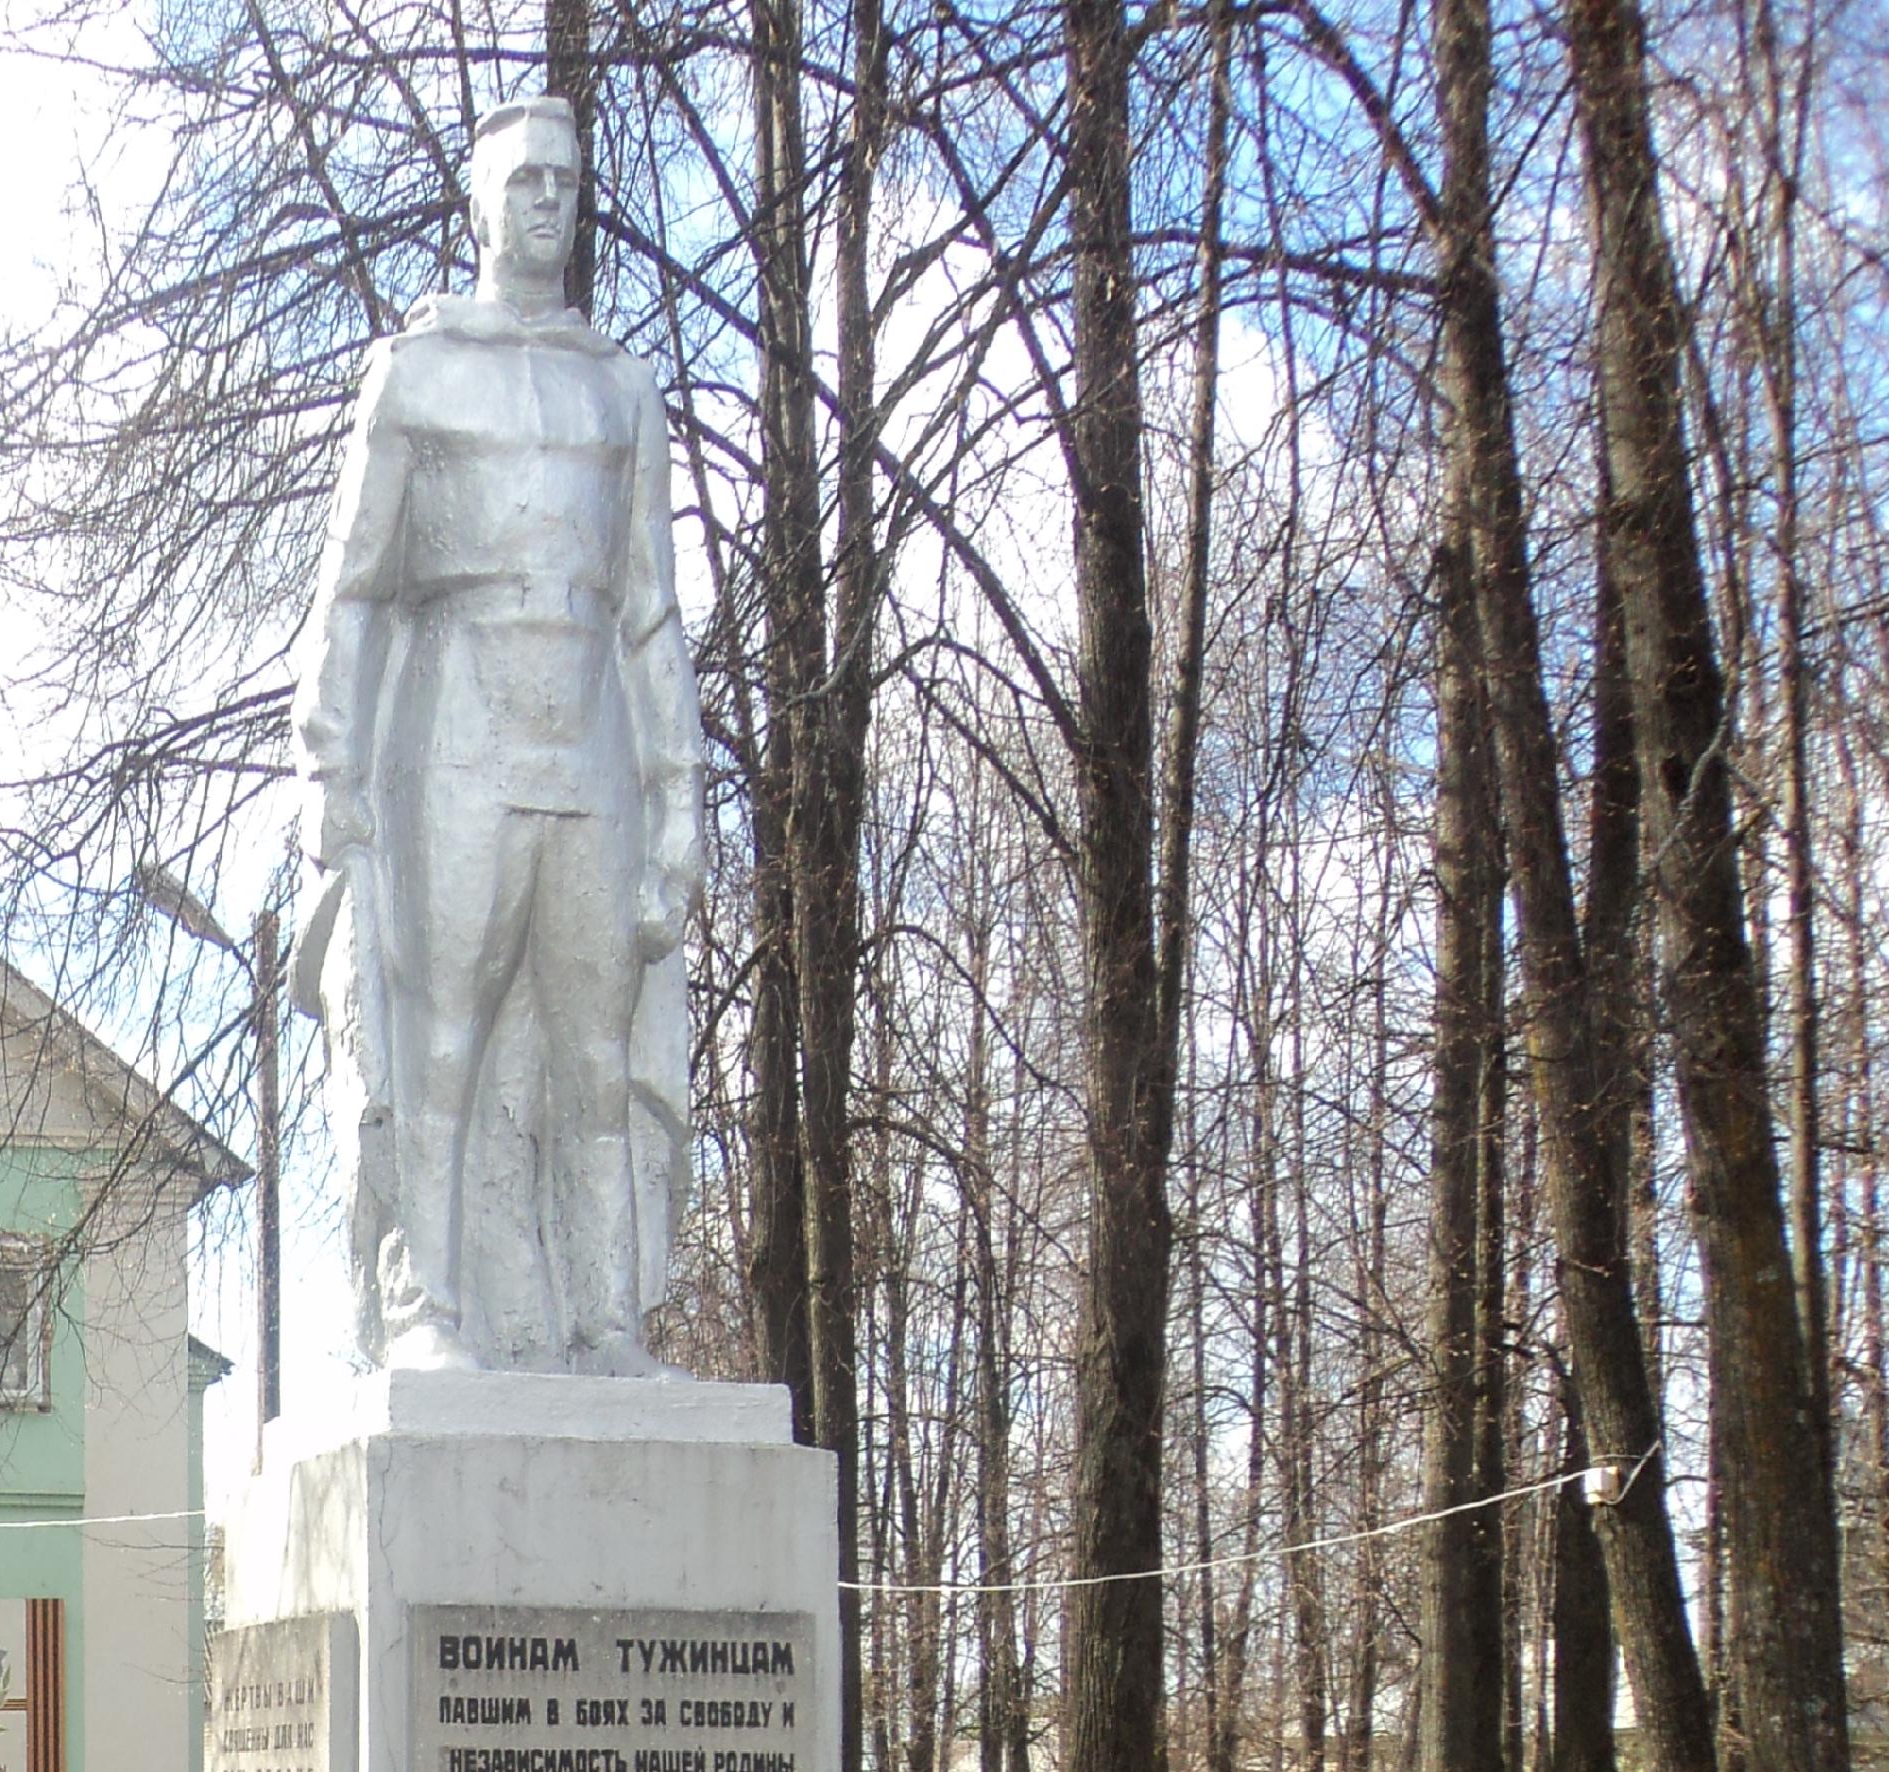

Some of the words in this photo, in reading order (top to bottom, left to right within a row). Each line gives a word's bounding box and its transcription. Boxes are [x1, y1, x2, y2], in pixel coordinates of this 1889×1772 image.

[439, 1635, 579, 1671] ВОИНАМ
[616, 1639, 794, 1676] ТУЖИНЦАМ
[224, 1683, 272, 1712] ЖЕРТВЫ
[277, 1679, 314, 1707] ВАШИ
[439, 1696, 531, 1724] ПАВШИМ
[547, 1698, 559, 1725] В
[576, 1698, 629, 1726] БОЯХ
[641, 1699, 667, 1726] ЗА
[680, 1701, 772, 1728] СВОБОДУ
[783, 1702, 795, 1728] И
[274, 1723, 292, 1749] ДЛЯ
[297, 1722, 314, 1748] НАС
